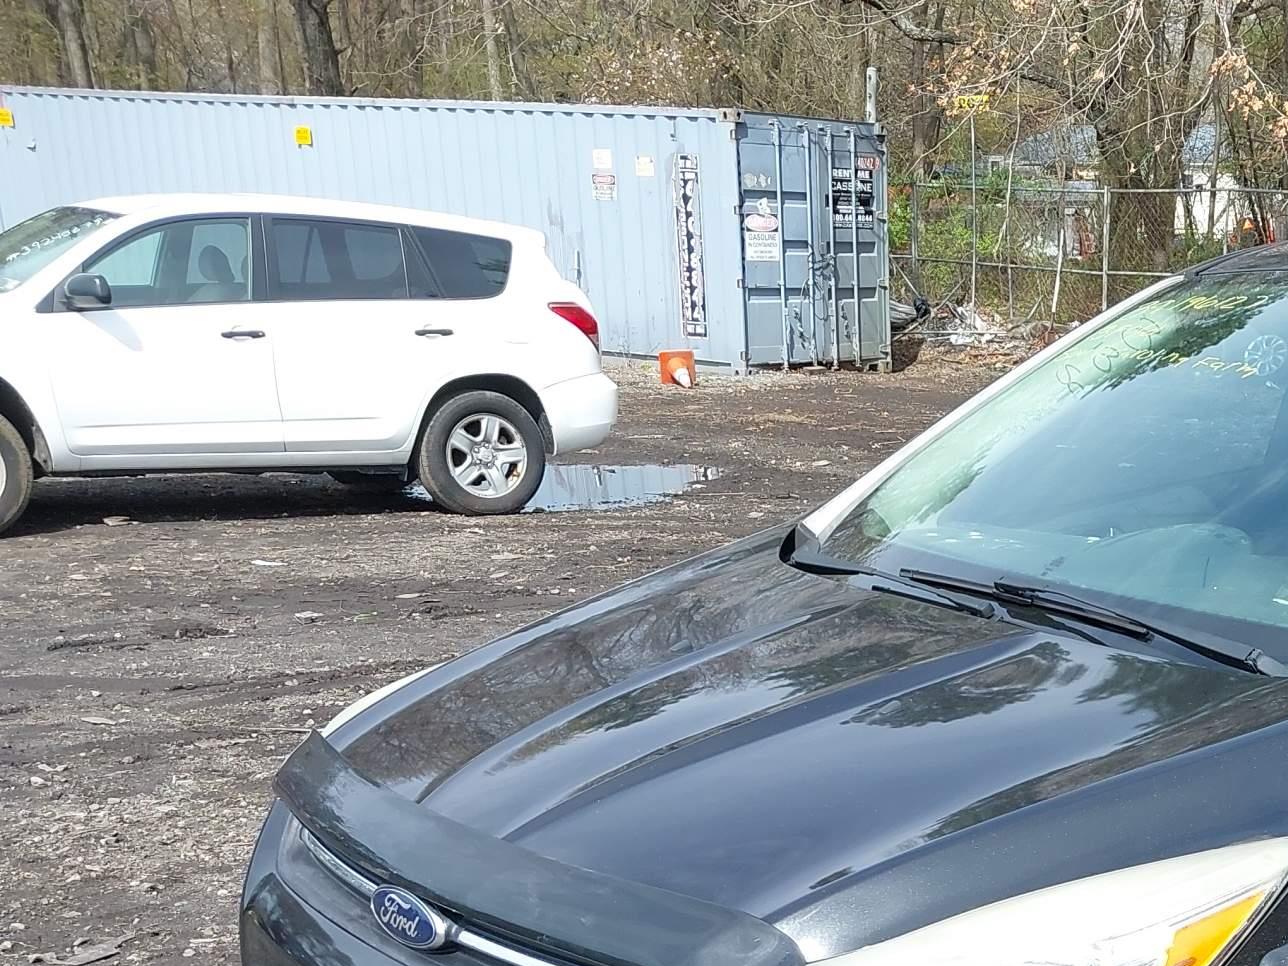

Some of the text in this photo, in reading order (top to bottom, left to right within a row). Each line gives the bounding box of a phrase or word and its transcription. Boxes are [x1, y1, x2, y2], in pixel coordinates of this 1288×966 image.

[832, 168, 870, 179] RENT ME
[748, 233, 777, 242] GASOLINE
[379, 893, 420, 938] Ford
